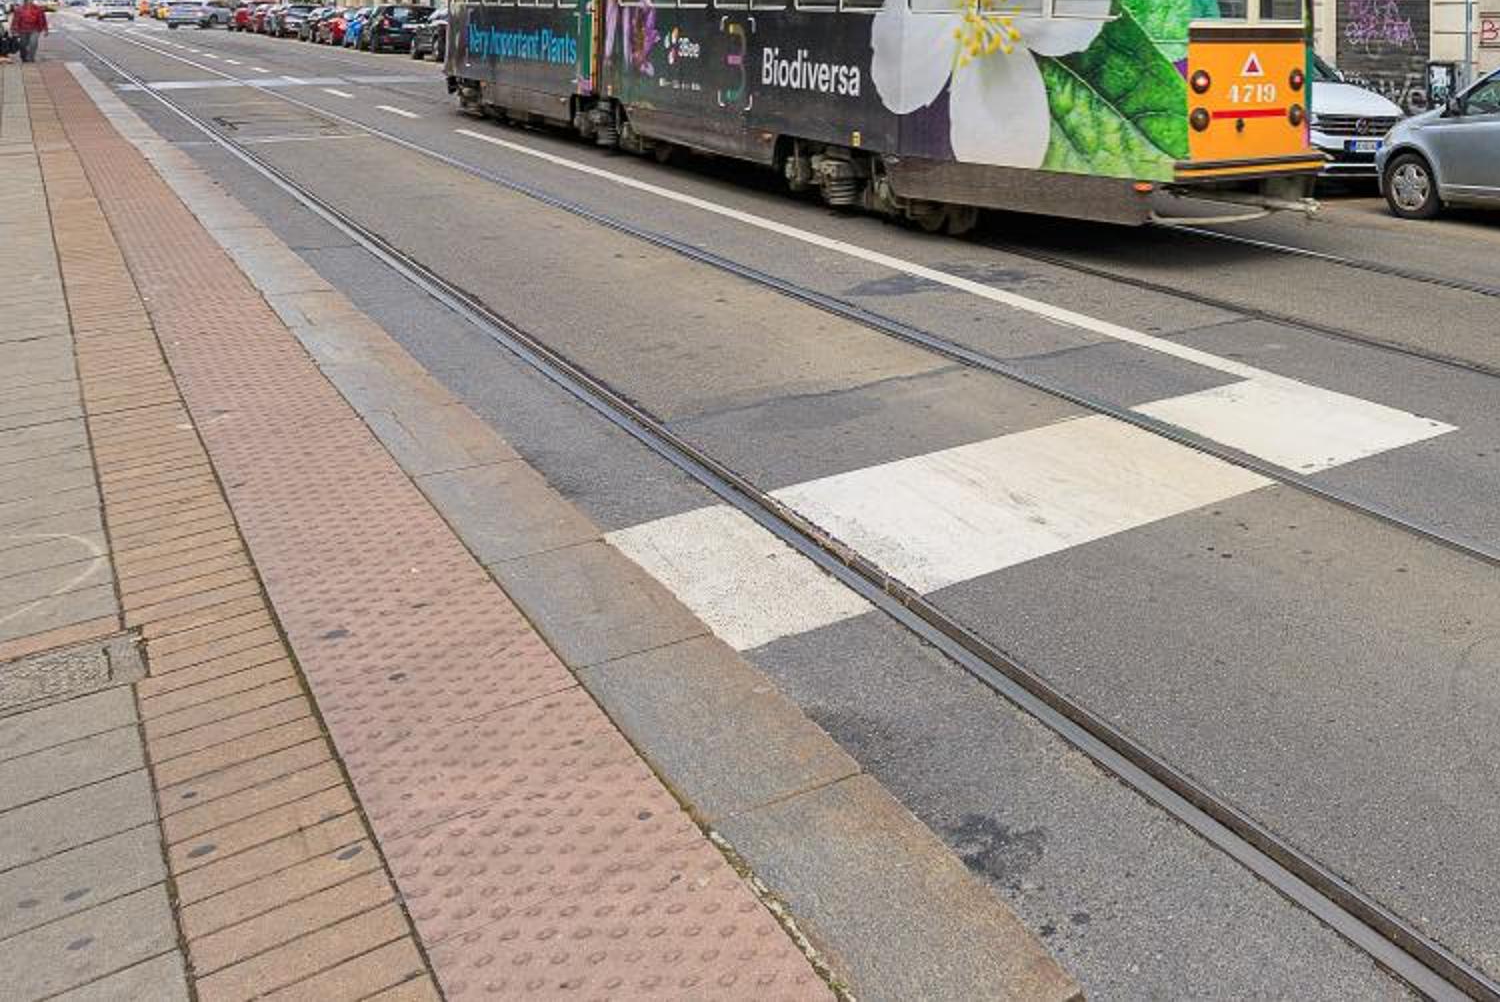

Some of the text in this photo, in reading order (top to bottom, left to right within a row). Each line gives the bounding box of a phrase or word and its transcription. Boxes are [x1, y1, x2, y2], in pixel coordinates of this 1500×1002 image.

[469, 23, 488, 58] Very
[541, 28, 577, 65] Plants
[762, 47, 860, 97] Biodiversa
[1229, 83, 1276, 103] 4719
